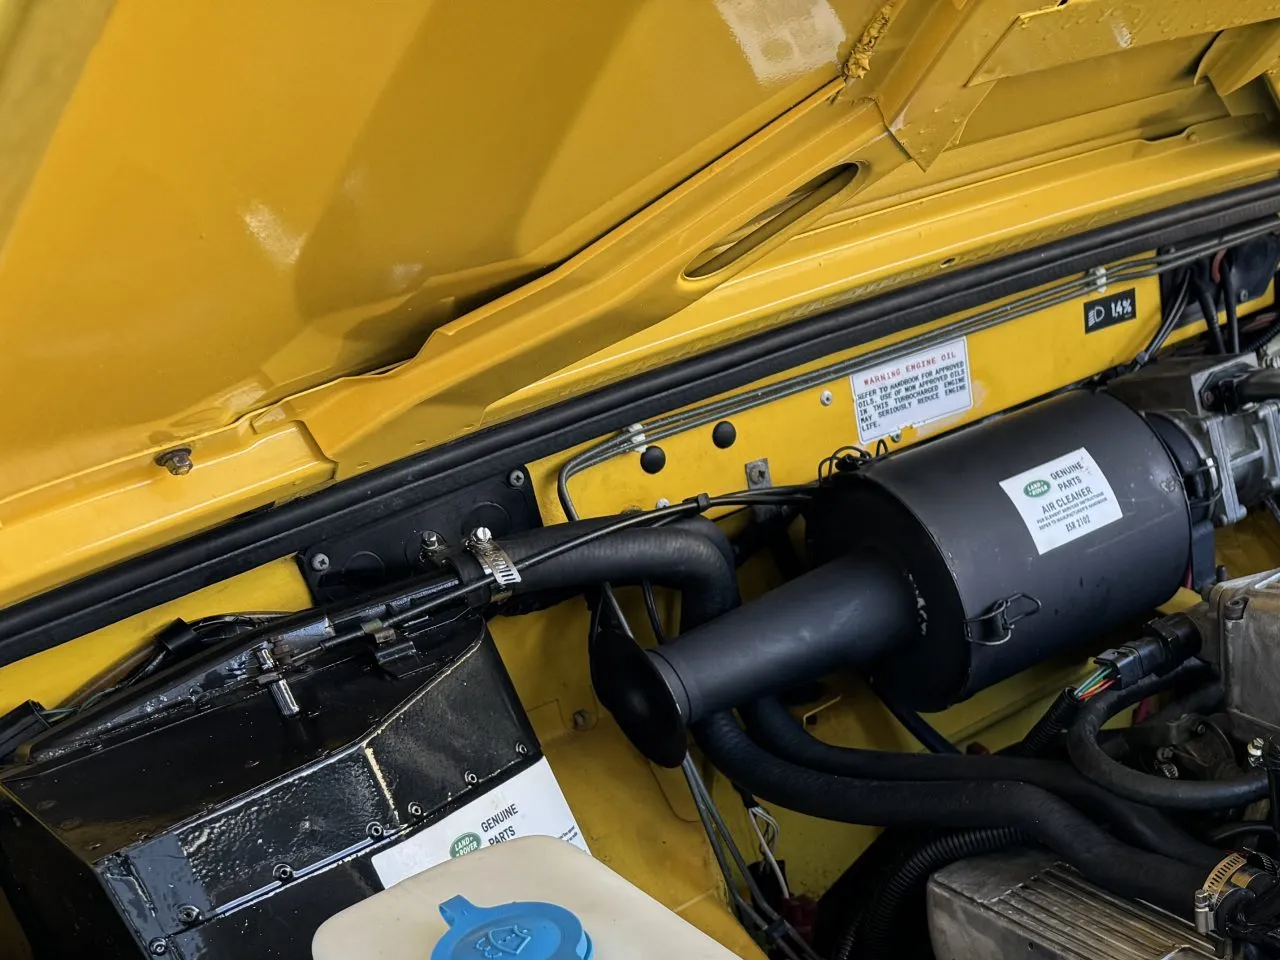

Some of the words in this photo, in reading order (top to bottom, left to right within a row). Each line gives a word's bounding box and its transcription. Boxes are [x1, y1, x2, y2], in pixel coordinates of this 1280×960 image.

[864, 368, 900, 386] WARNING
[906, 358, 936, 373] ENGINE
[941, 352, 956, 361] OIL
[857, 388, 876, 400] REFER
[890, 375, 919, 390] HANDBOOK
[922, 371, 933, 379] FOR
[935, 360, 964, 375] APPROVED
[880, 393, 892, 401] USE
[904, 384, 916, 392] NON
[918, 375, 948, 390] APPROVED
[950, 369, 965, 378] OILS
[861, 415, 872, 424] MAY
[878, 401, 912, 418] SERIOUSLY
[917, 394, 940, 405] REDUCE
[944, 384, 966, 396] ENGINE
[874, 402, 888, 411] THIS
[894, 385, 938, 404] TURBOCHARGED
[944, 377, 966, 388] ENGINE
[1050, 461, 1084, 480] GENUINE
[1027, 480, 1042, 491] LAND
[1032, 484, 1048, 496] ROVER
[1057, 476, 1082, 492] PARTS
[1041, 501, 1056, 514] AIR
[1056, 486, 1093, 508] CLEANER
[1066, 522, 1078, 532] ESR
[480, 803, 519, 832] GENUINE
[454, 836, 470, 851] LAND
[488, 825, 516, 846] PARTS
[459, 841, 478, 856] ROVER
